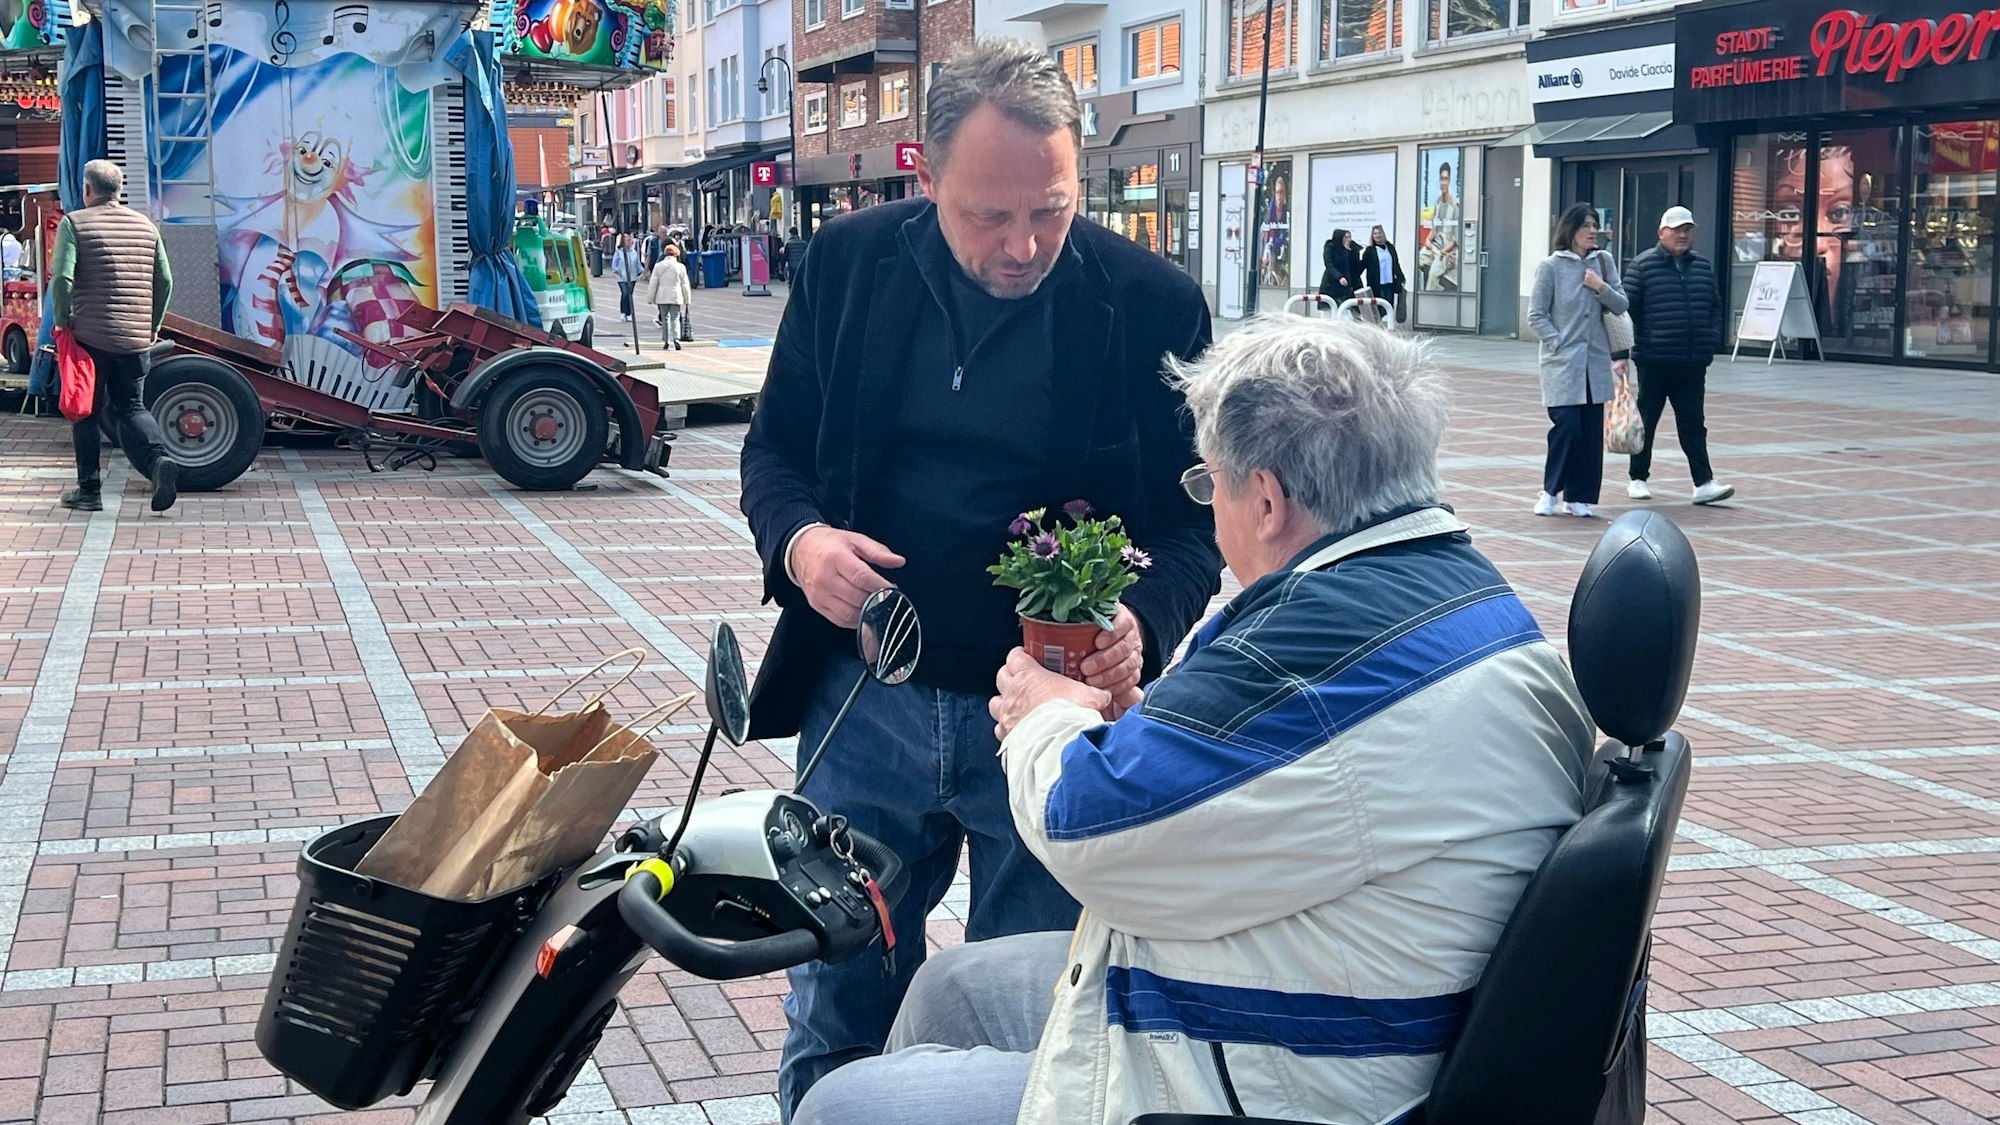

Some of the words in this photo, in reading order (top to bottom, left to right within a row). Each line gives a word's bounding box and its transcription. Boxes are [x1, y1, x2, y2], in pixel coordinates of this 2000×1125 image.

[1716, 26, 1777, 56] STADT-
[1810, 9, 2000, 83] Pieper
[1538, 74, 1570, 89] Allianz
[1609, 65, 1639, 80] Davide
[1640, 61, 1673, 76] Ciaccia
[1691, 55, 1802, 89] PARFÜMERIE
[1081, 102, 1097, 136] k
[1170, 153, 1179, 171] 11
[758, 167, 771, 182] T
